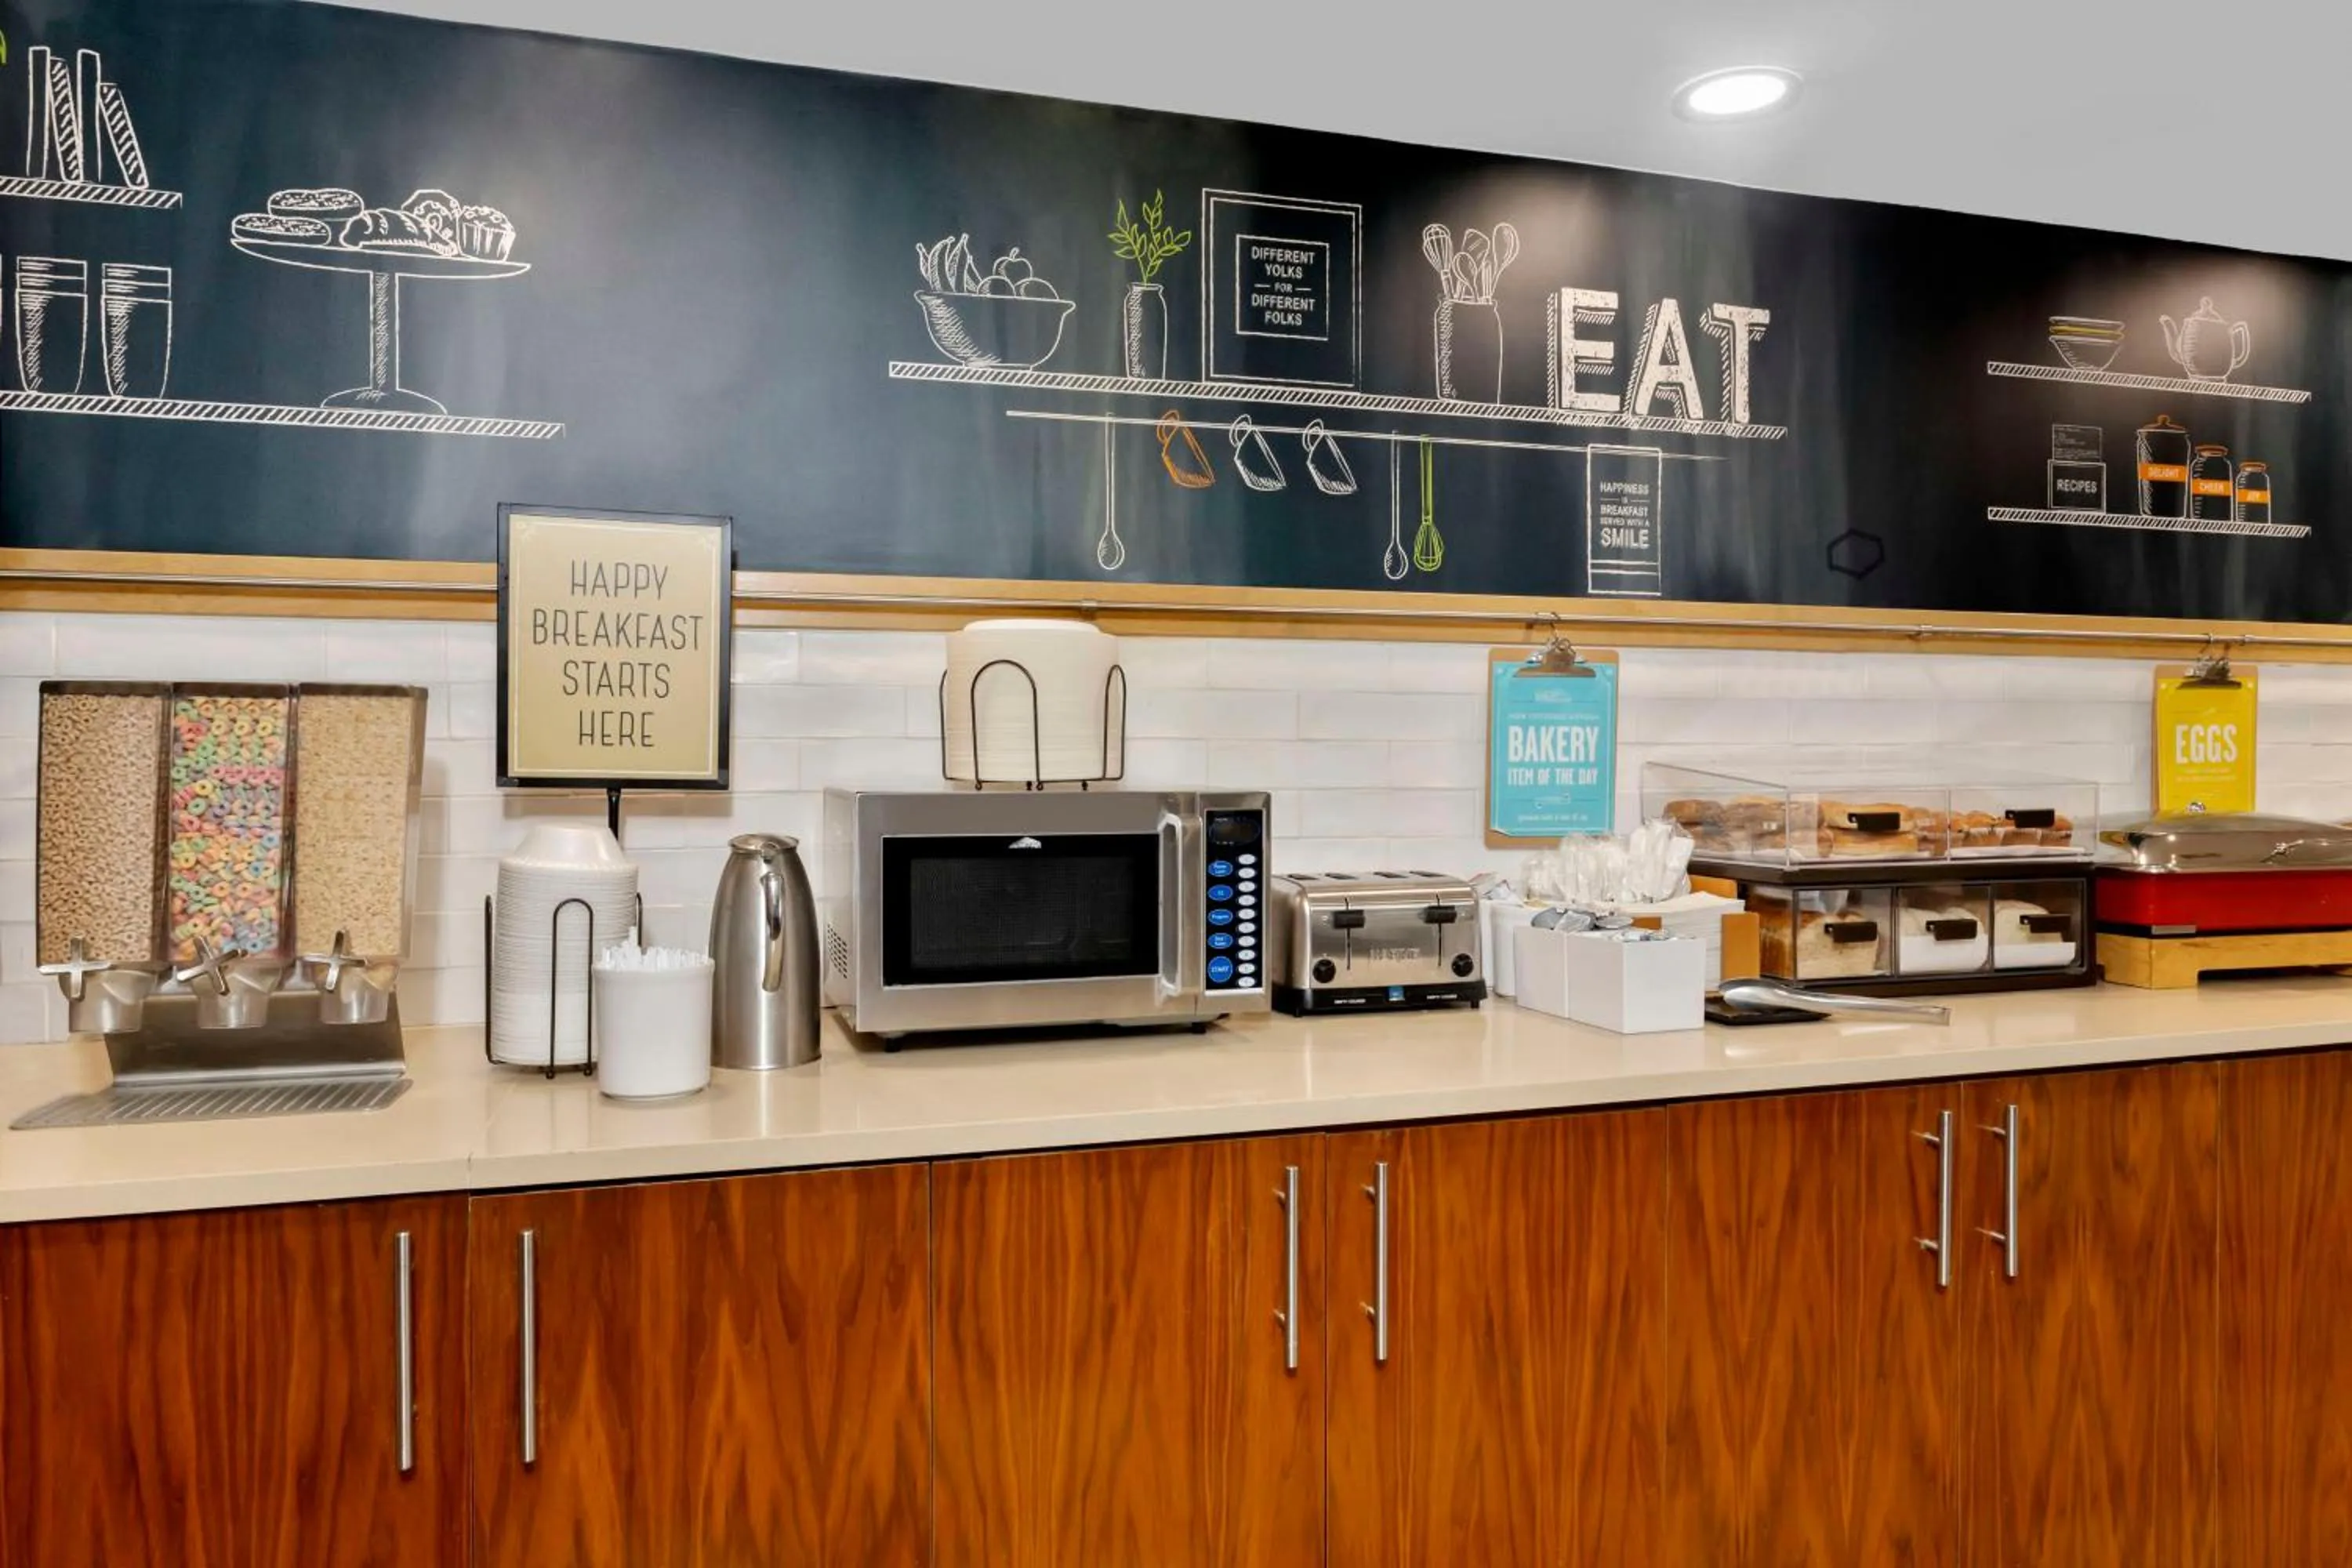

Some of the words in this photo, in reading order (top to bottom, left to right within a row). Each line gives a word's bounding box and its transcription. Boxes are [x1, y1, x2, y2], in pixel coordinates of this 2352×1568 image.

[1251, 245, 1315, 264] DIFFERENT
[1265, 263, 1303, 279] YOLKS
[1274, 282, 1293, 292] FOR
[1251, 293, 1316, 311] DIFFERENT
[1265, 310, 1303, 326] FOLKS
[1547, 287, 1770, 424] EAT
[1600, 481, 1650, 495] HAPPINESS
[2056, 478, 2098, 494] RECIPES
[1600, 504, 1649, 517] BREAKFAST
[1601, 527, 1650, 549] SMILE
[571, 559, 668, 600] HAPPY
[532, 608, 703, 651] BREAKFAST
[562, 659, 671, 699] STARTS
[579, 709, 655, 747] HERE
[1507, 724, 1600, 763] BAKERY
[2175, 723, 2238, 764] EGGS
[1508, 768, 1534, 786] ITEM
[1537, 768, 1550, 786] OF
[1555, 768, 1573, 786] THE
[1578, 767, 1598, 785] DAY
